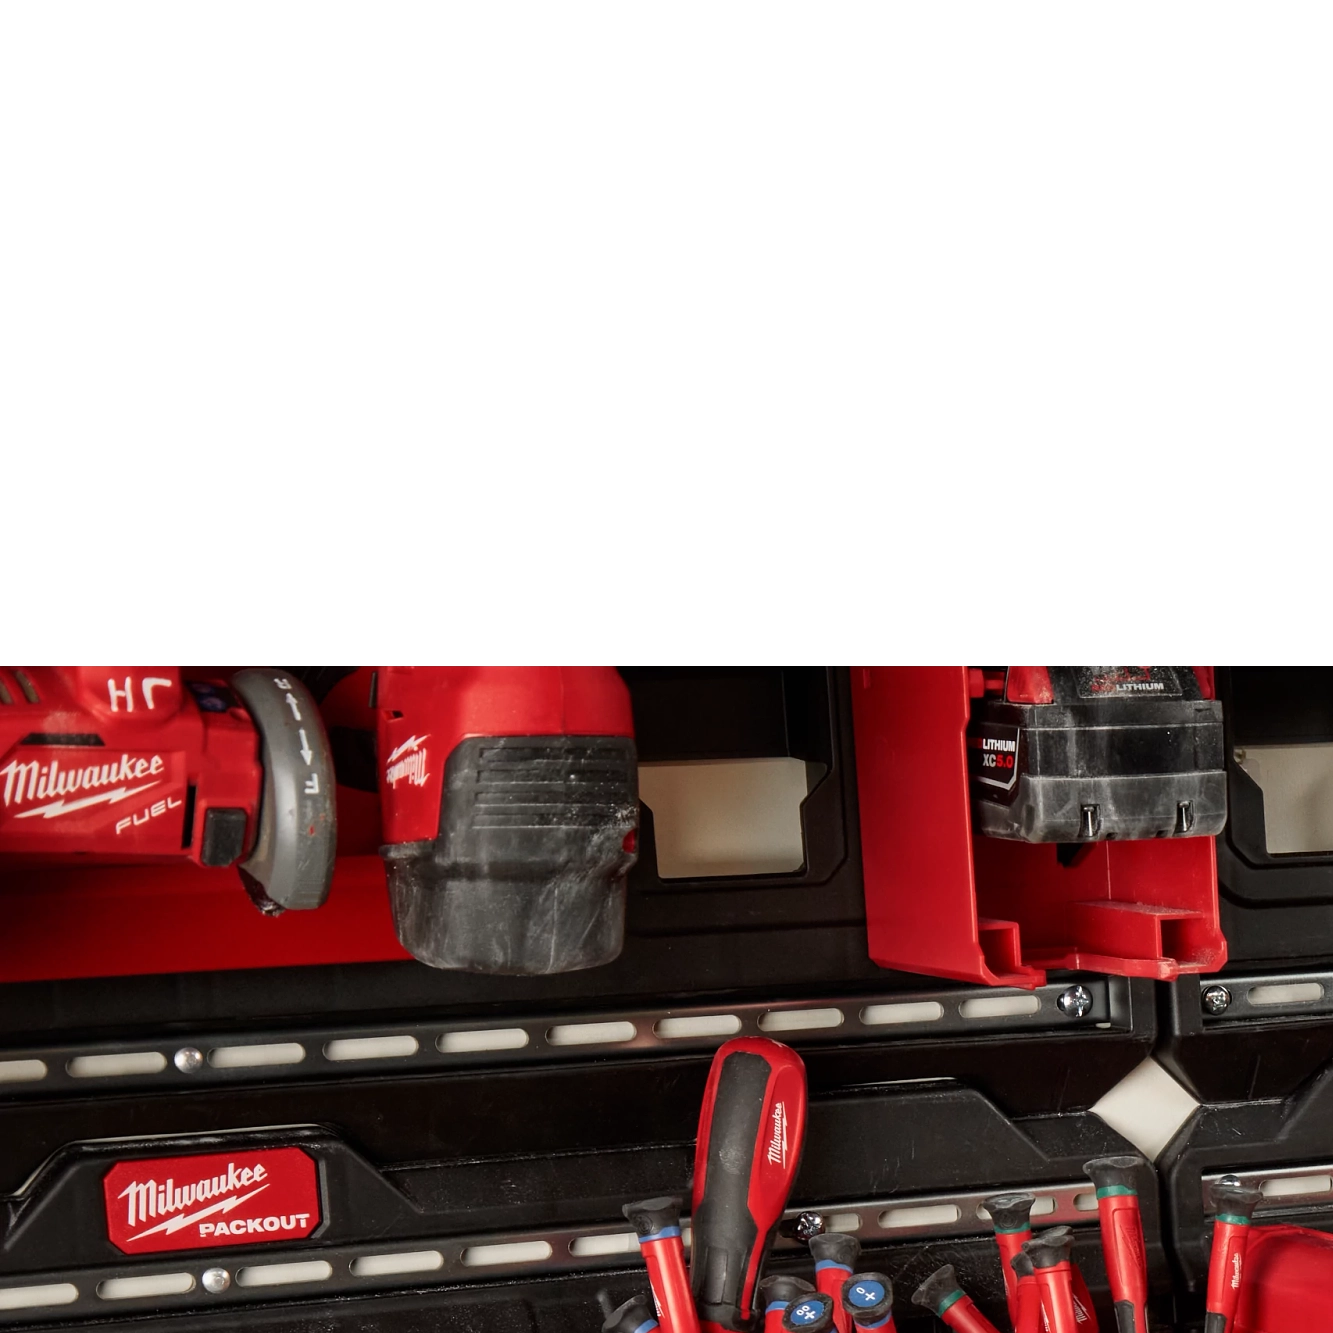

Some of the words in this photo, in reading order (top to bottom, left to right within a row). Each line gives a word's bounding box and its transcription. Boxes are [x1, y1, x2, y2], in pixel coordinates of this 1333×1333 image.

[1, 754, 165, 807] Milwaukee
[982, 753, 1014, 769] XC5.0
[304, 773, 320, 794] F
[115, 797, 182, 836] FUEL
[767, 1102, 783, 1164] Milwaukee
[118, 1163, 268, 1226] Milwaukee
[198, 1212, 310, 1237] PACKOUT
